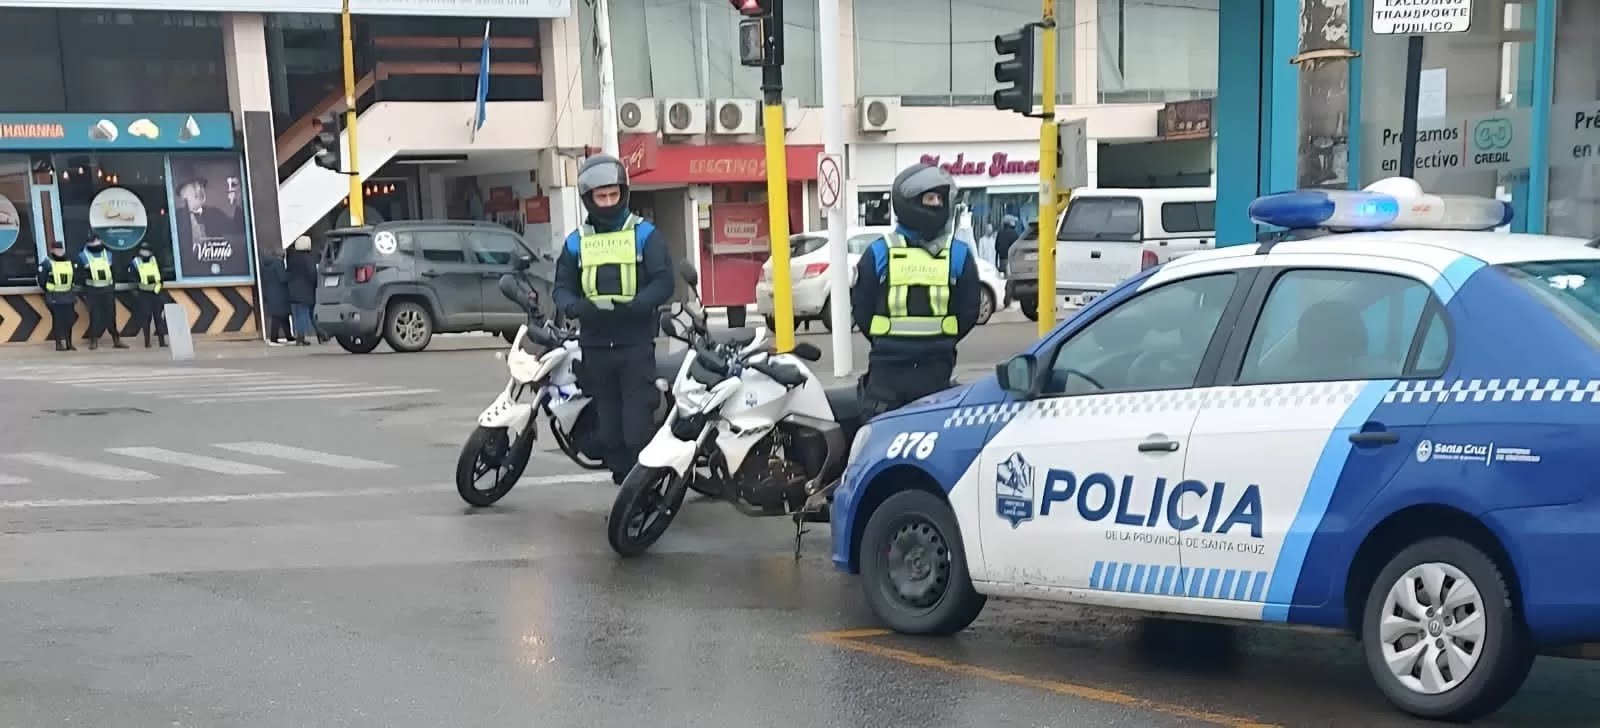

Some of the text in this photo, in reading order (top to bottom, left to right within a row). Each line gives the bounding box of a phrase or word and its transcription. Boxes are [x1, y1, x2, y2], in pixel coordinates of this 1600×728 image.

[1376, 8, 1468, 19] TRANSPORTE
[4, 124, 64, 138] HAVANNA
[1474, 152, 1511, 164] CREDIL
[1572, 144, 1591, 158] en
[1382, 159, 1397, 171] en
[887, 432, 938, 460] 876
[1434, 443, 1462, 454] Santa
[1464, 444, 1487, 455] Cruz
[1039, 468, 1264, 538] POLICIA
[1186, 538, 1198, 548] DE
[1201, 539, 1234, 551] SANTA
[1237, 543, 1265, 555] CRUZ
